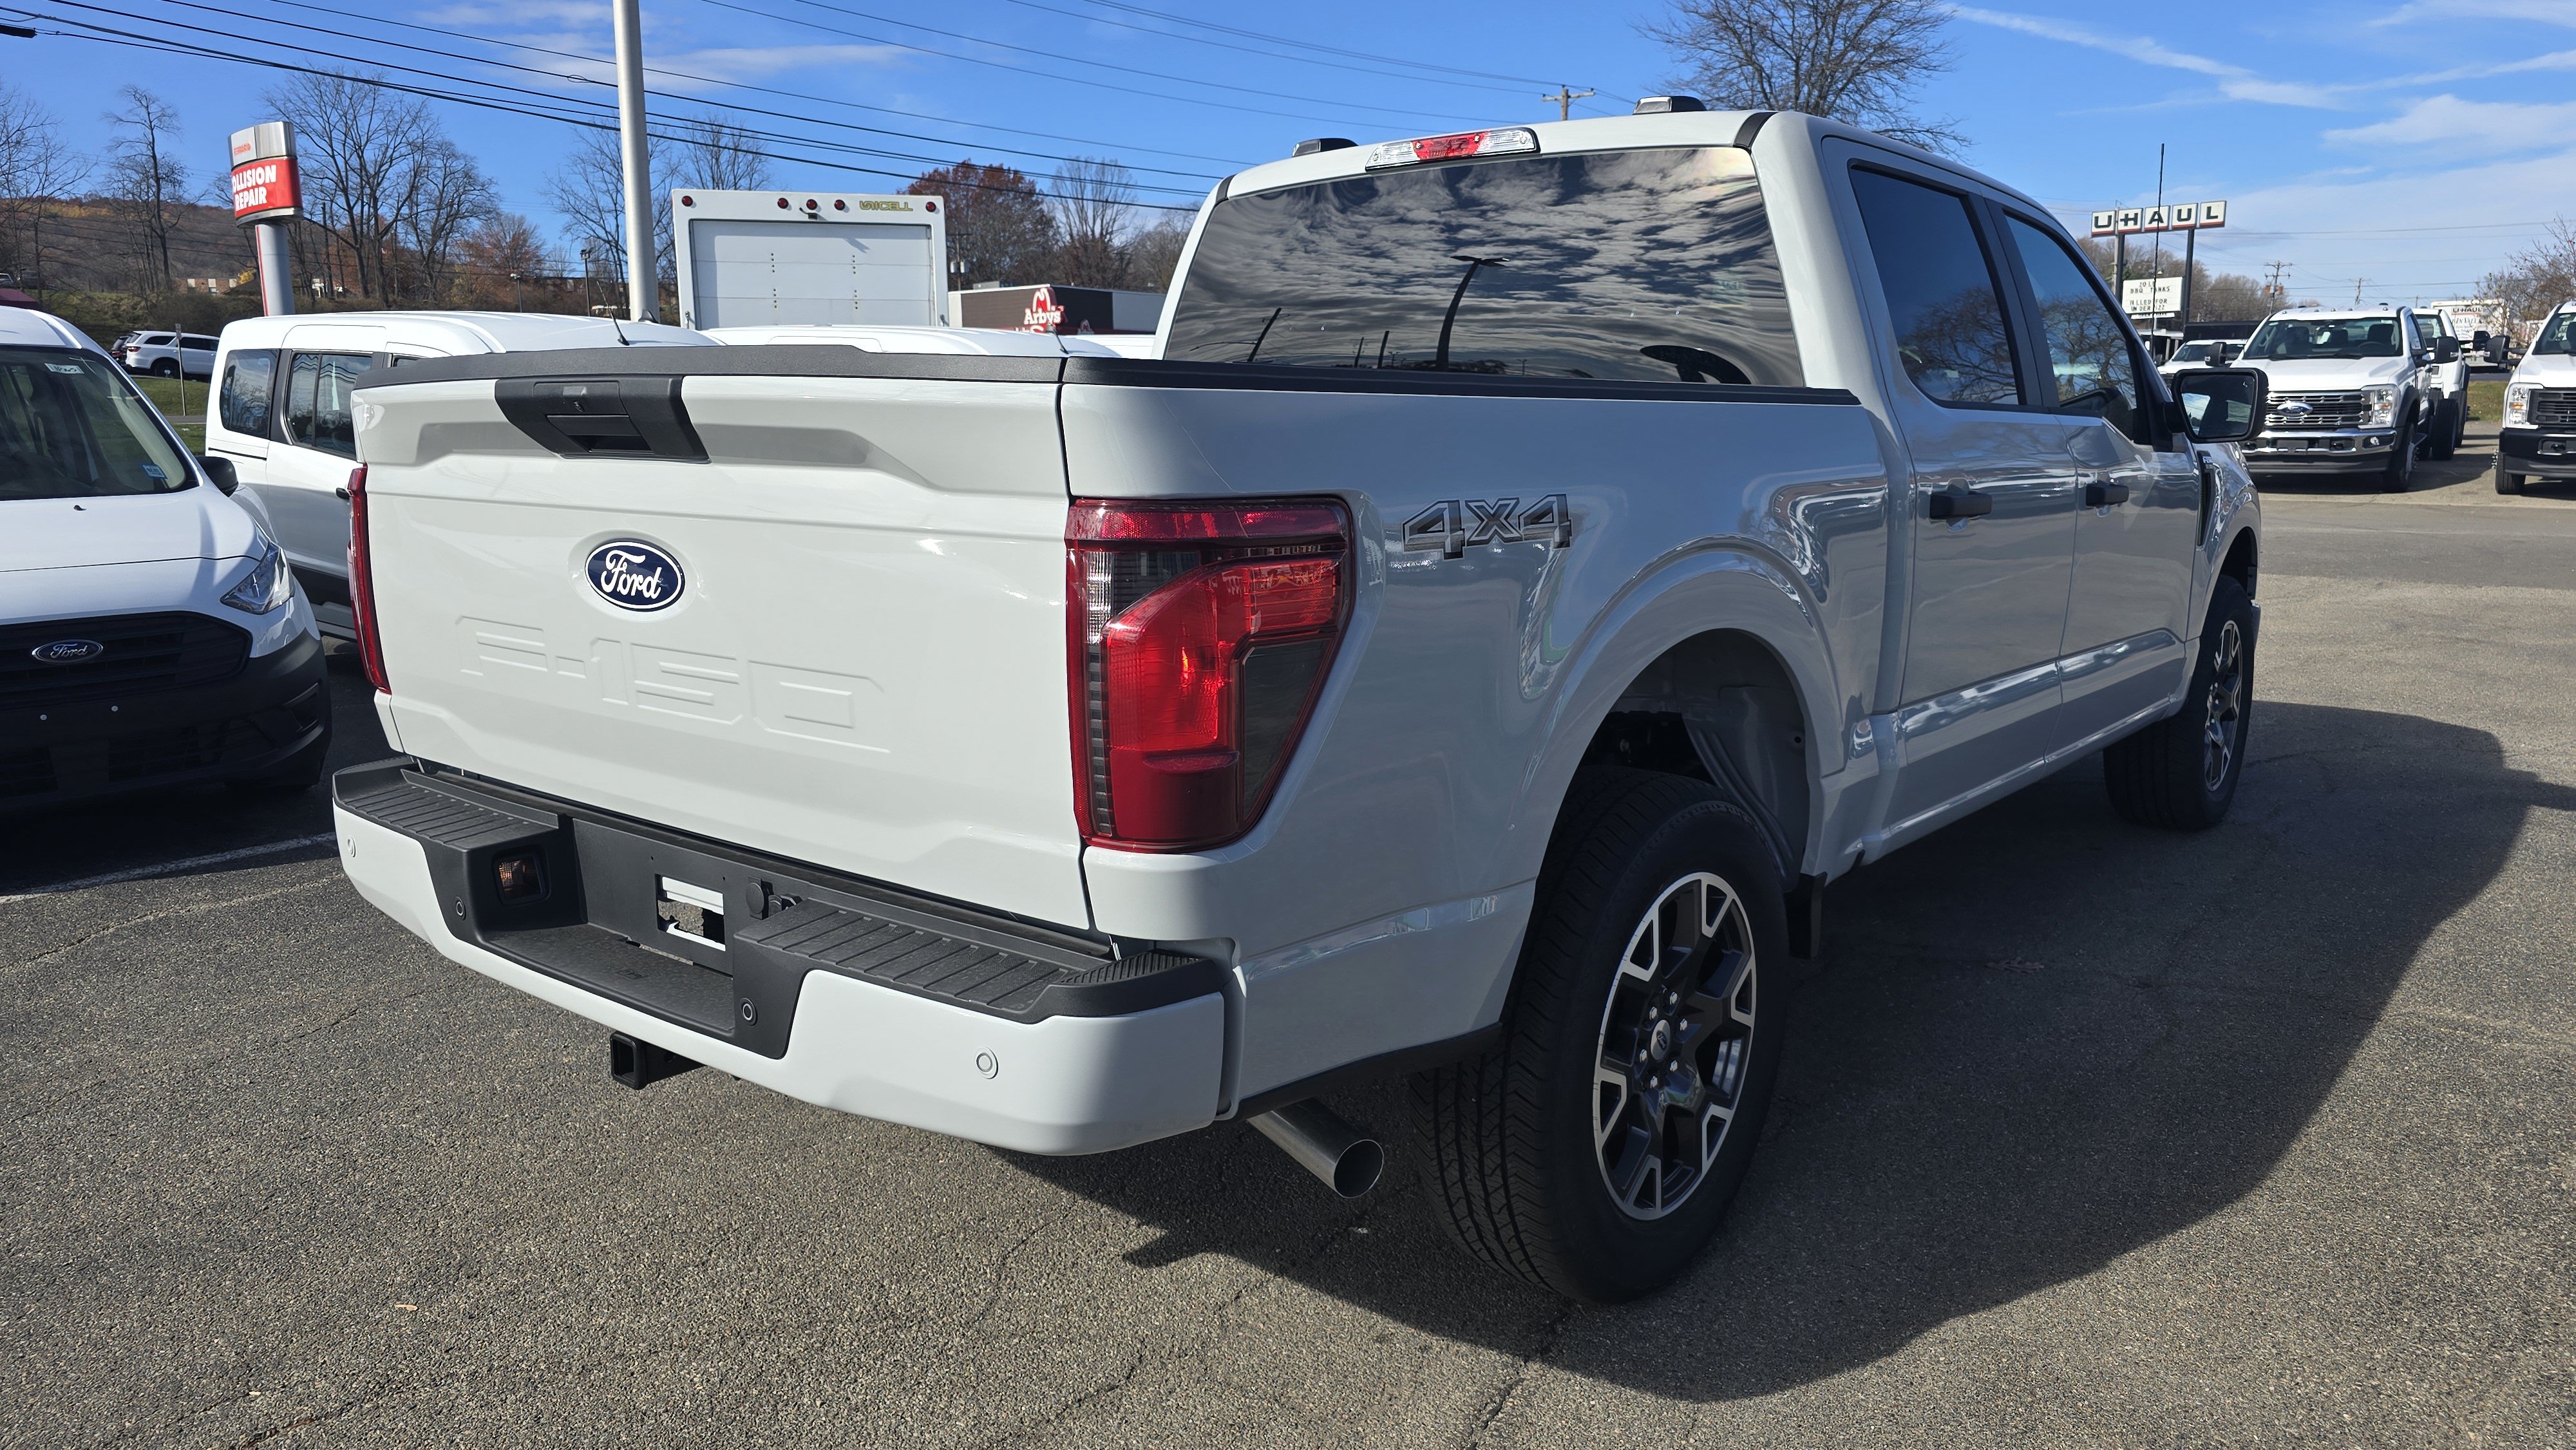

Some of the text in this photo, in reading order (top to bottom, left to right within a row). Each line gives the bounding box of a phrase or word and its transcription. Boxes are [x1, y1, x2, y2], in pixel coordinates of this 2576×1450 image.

[232, 165, 276, 193] OLLISION
[235, 186, 267, 211] REPAIR
[601, 550, 662, 599] Ford
[50, 643, 88, 658] Ford
[456, 616, 891, 753] F-150
